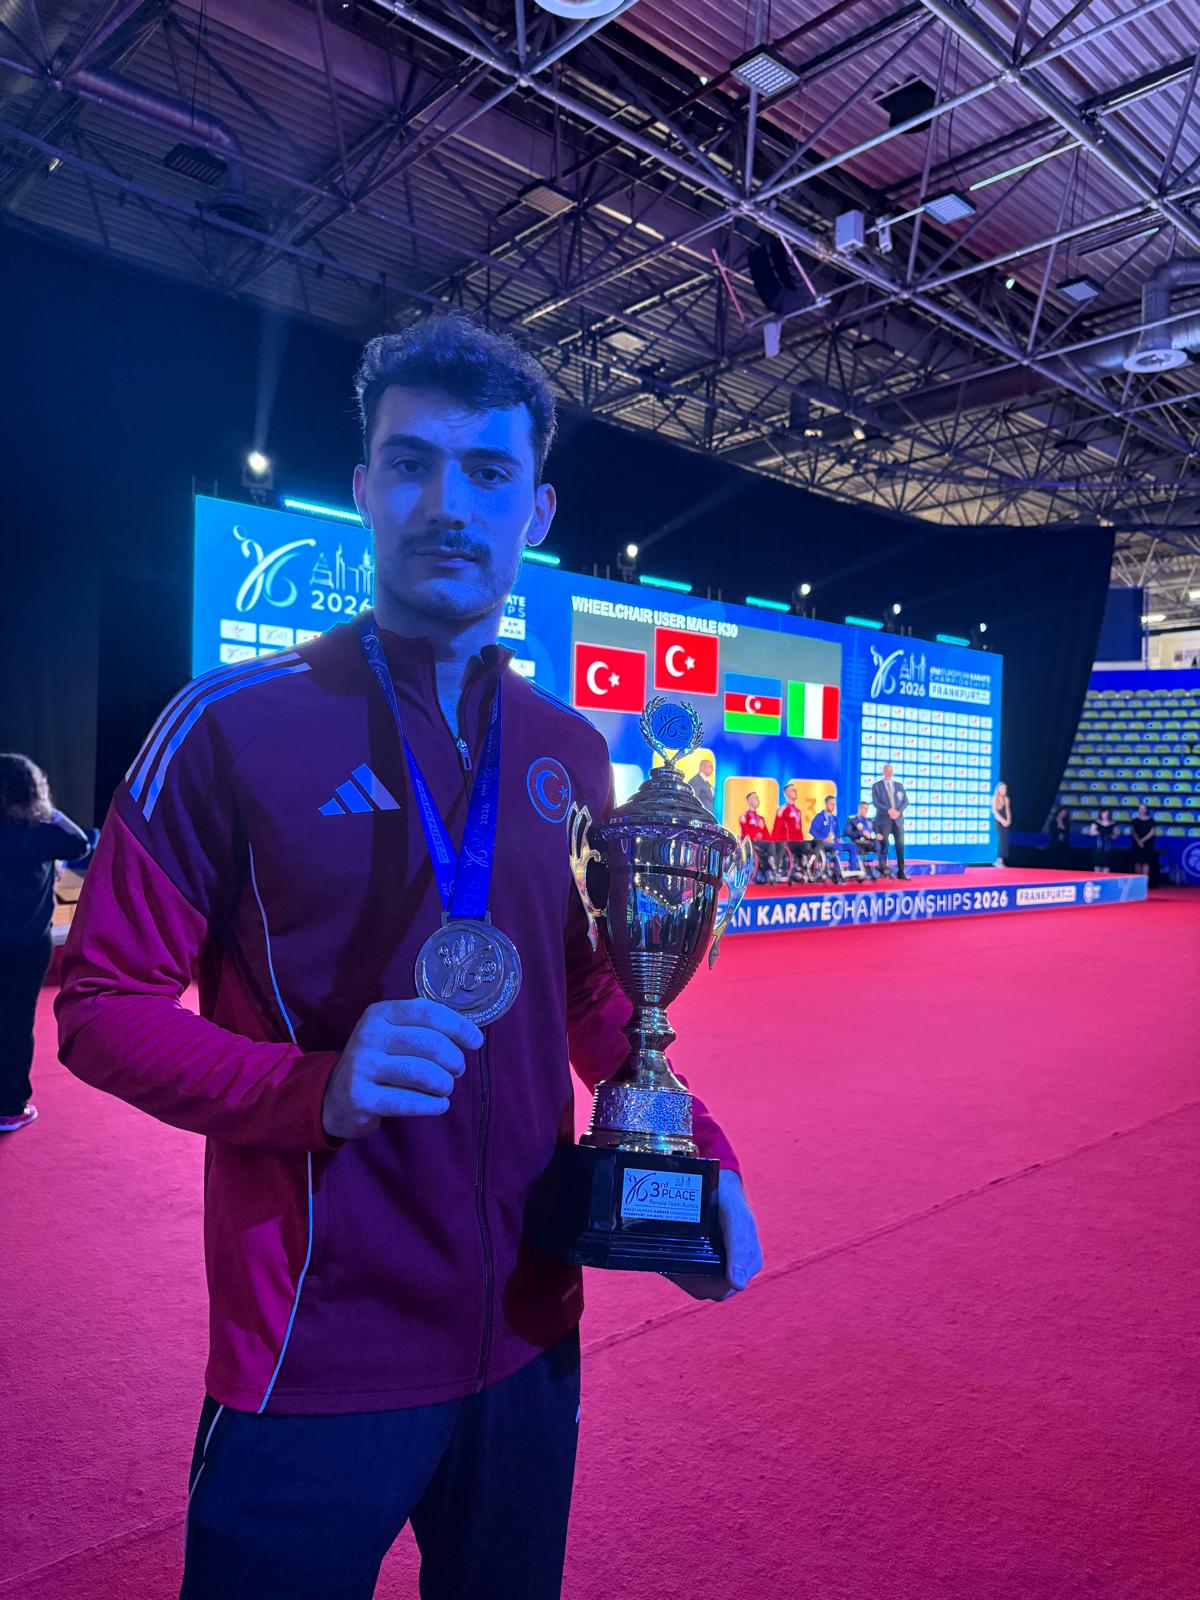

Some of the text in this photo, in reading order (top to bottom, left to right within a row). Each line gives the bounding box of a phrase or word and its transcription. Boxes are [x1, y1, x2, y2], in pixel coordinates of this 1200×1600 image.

[572, 595, 652, 624] WHEELCHAIR
[653, 610, 686, 630] USER
[686, 615, 718, 635] MALE
[899, 680, 926, 698] 2026
[932, 685, 980, 700] FRANKFURT
[479, 803, 490, 825] 2026
[757, 901, 832, 926] KARATE
[831, 892, 972, 920] CHAMPIONSHIPS
[973, 890, 1009, 910] 2026
[1019, 889, 1067, 902] FRANKFURT
[661, 1188, 696, 1201] PLACE
